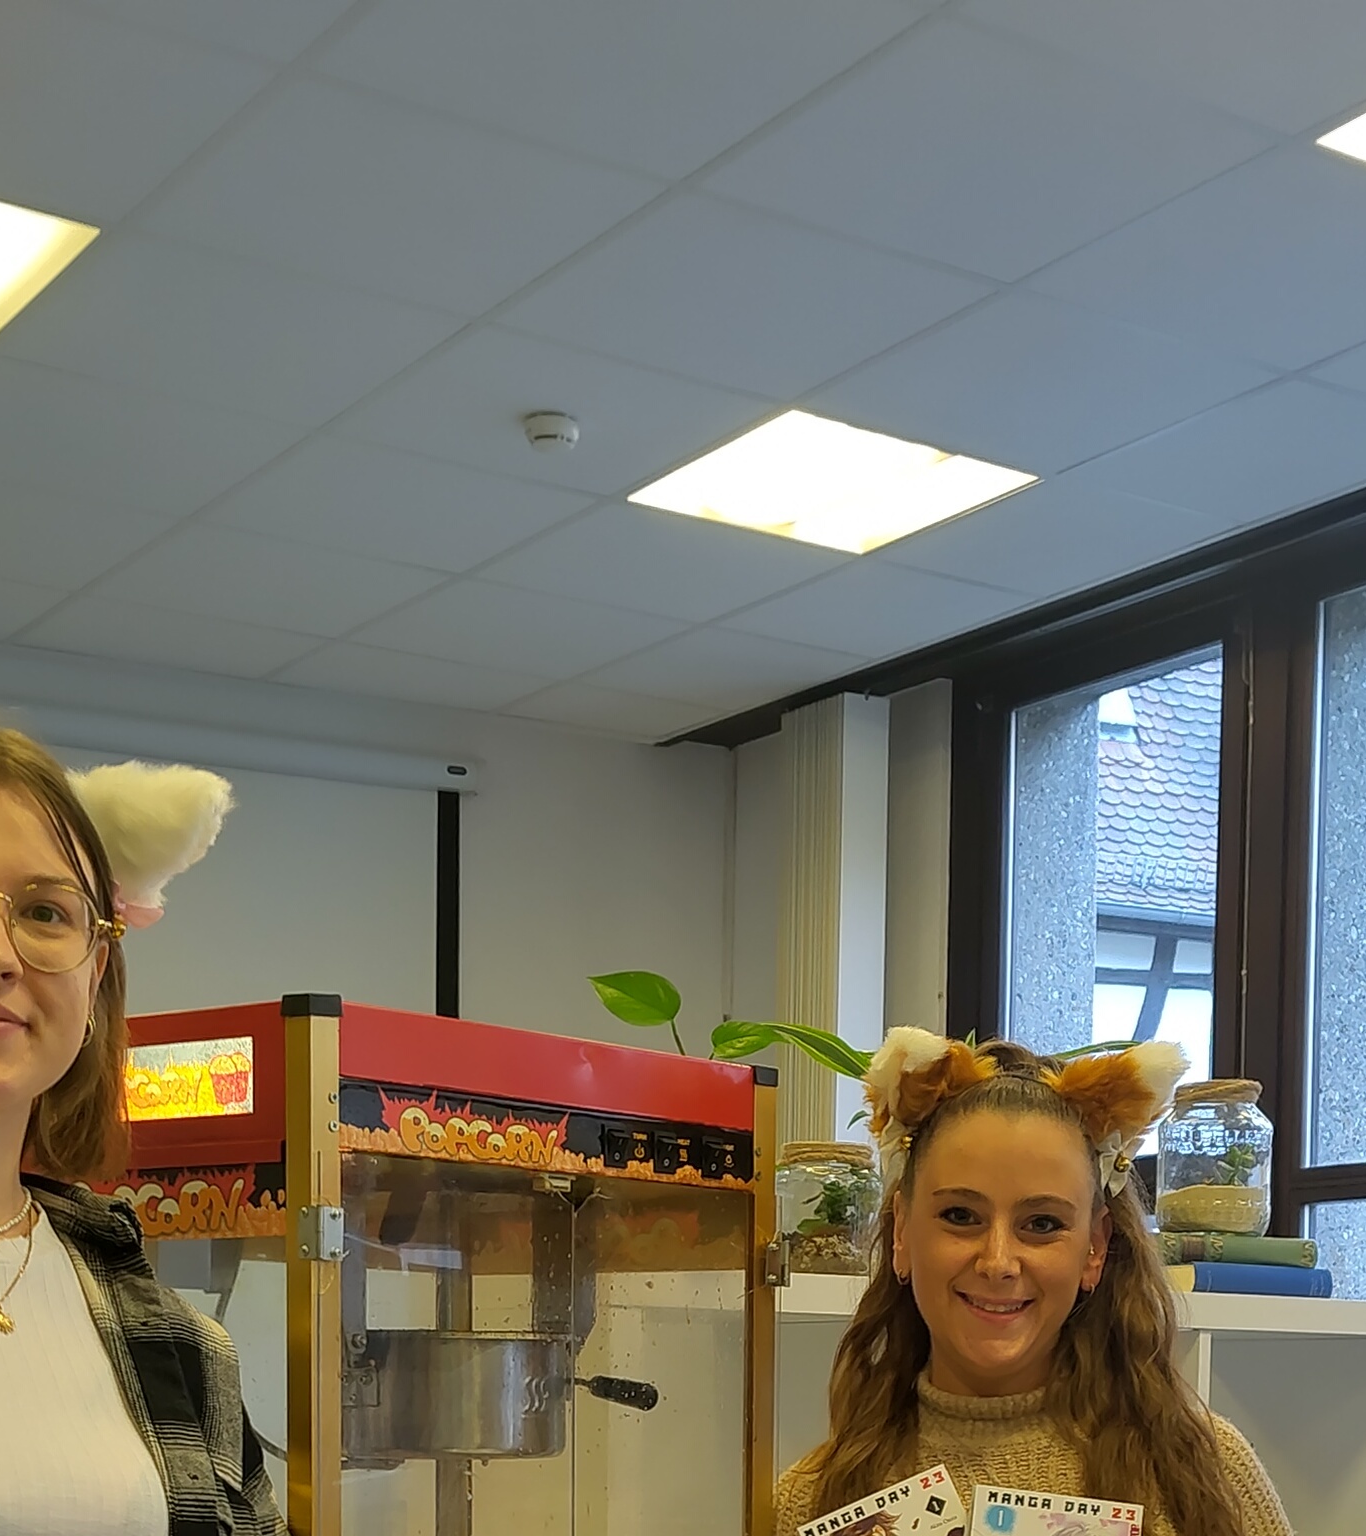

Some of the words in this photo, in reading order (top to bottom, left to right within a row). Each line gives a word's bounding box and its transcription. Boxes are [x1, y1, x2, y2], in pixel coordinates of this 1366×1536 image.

[875, 1485, 911, 1509] DAY
[920, 1471, 945, 1489] 23
[988, 1491, 1052, 1509] MANGA
[1065, 1501, 1101, 1516] DAY
[1112, 1507, 1136, 1521] 23
